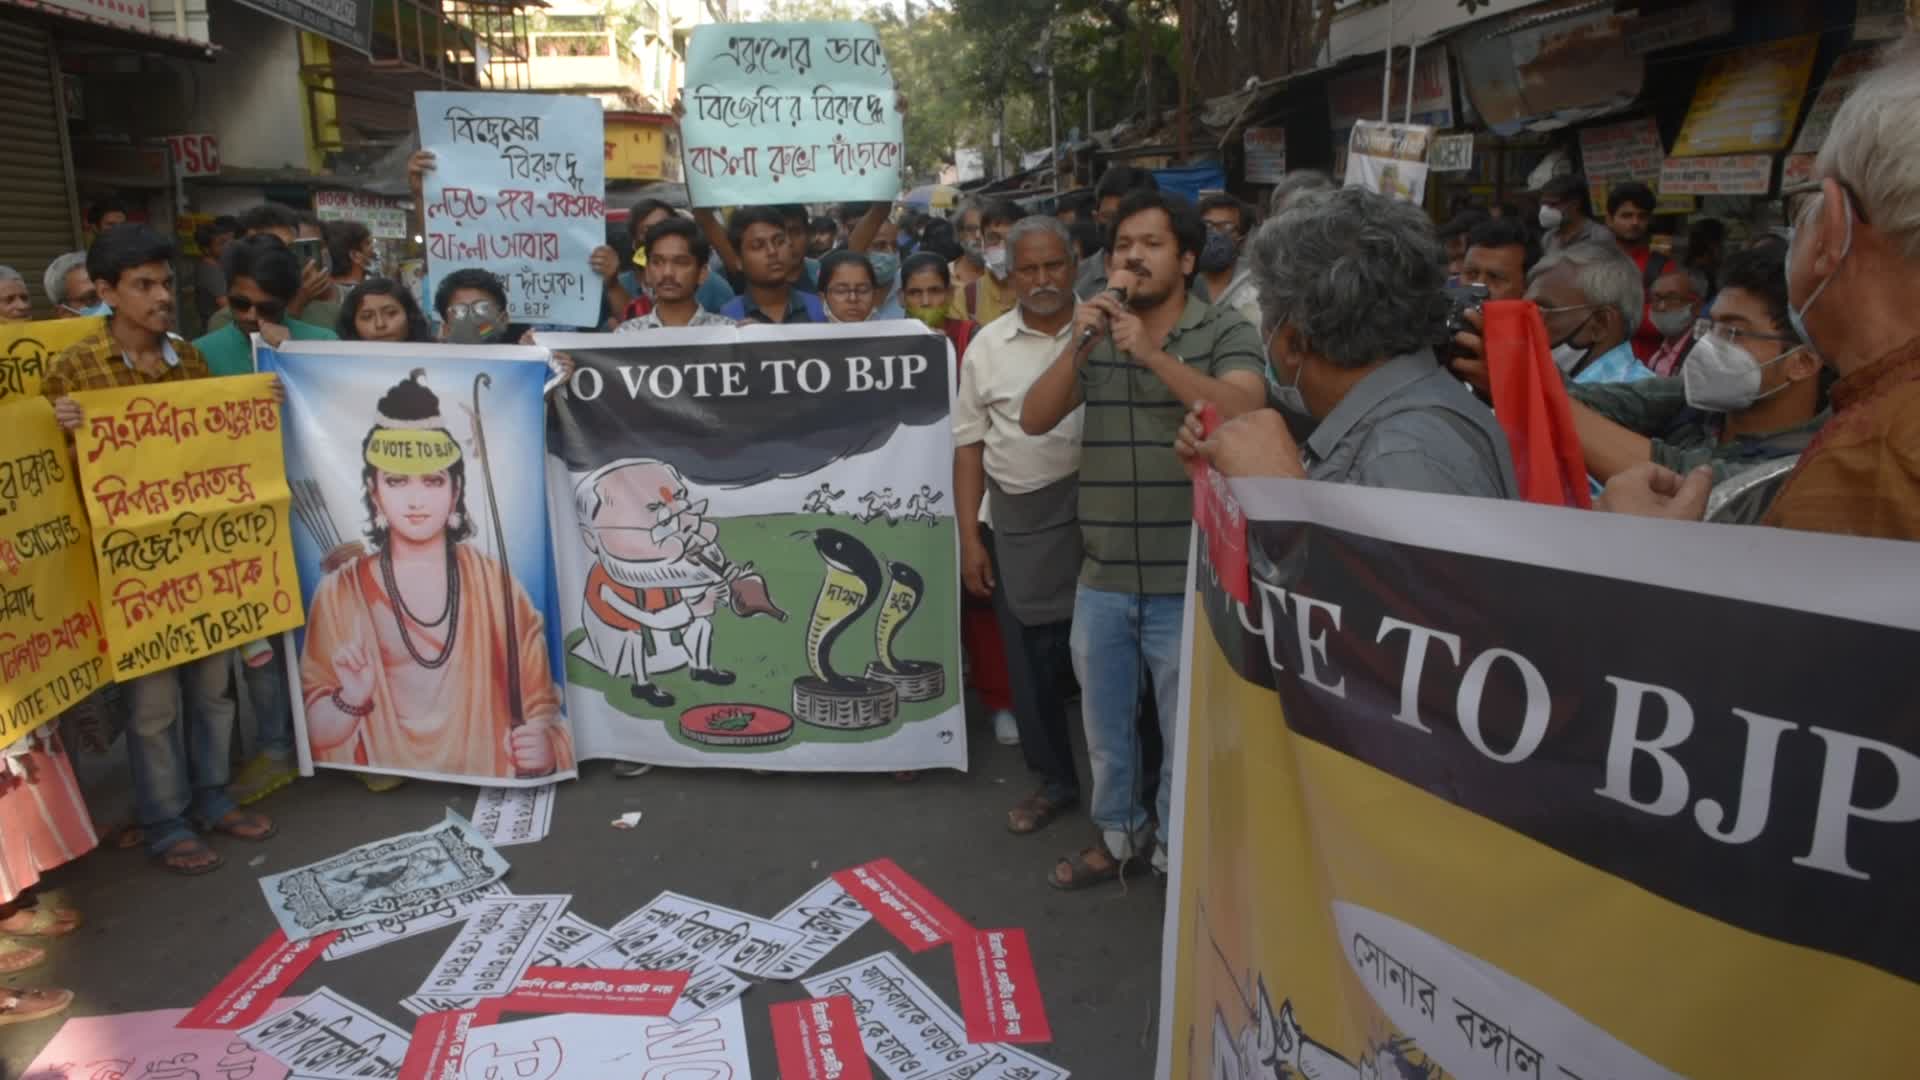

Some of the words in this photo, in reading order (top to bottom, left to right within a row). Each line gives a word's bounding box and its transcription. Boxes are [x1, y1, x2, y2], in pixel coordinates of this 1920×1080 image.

[712, 37, 812, 75] একুশের
[688, 146, 759, 178] বাংলা
[496, 189, 535, 222] হবে
[429, 233, 489, 262] বাংলা
[491, 232, 561, 262] আবার
[523, 303, 550, 315] BJP
[560, 366, 604, 401] O
[618, 362, 749, 401] VOTE
[761, 358, 831, 394] TO
[844, 353, 928, 393] BJP
[383, 440, 413, 458] VOTE
[415, 441, 433, 457] TO
[112, 572, 202, 629] নিপাত
[8, 687, 44, 729] VOTE
[45, 679, 71, 706] TO
[71, 655, 104, 695] BJP
[1375, 616, 1552, 764] TO
[1594, 674, 1920, 880] BJP
[1353, 931, 1439, 1024] সোনার
